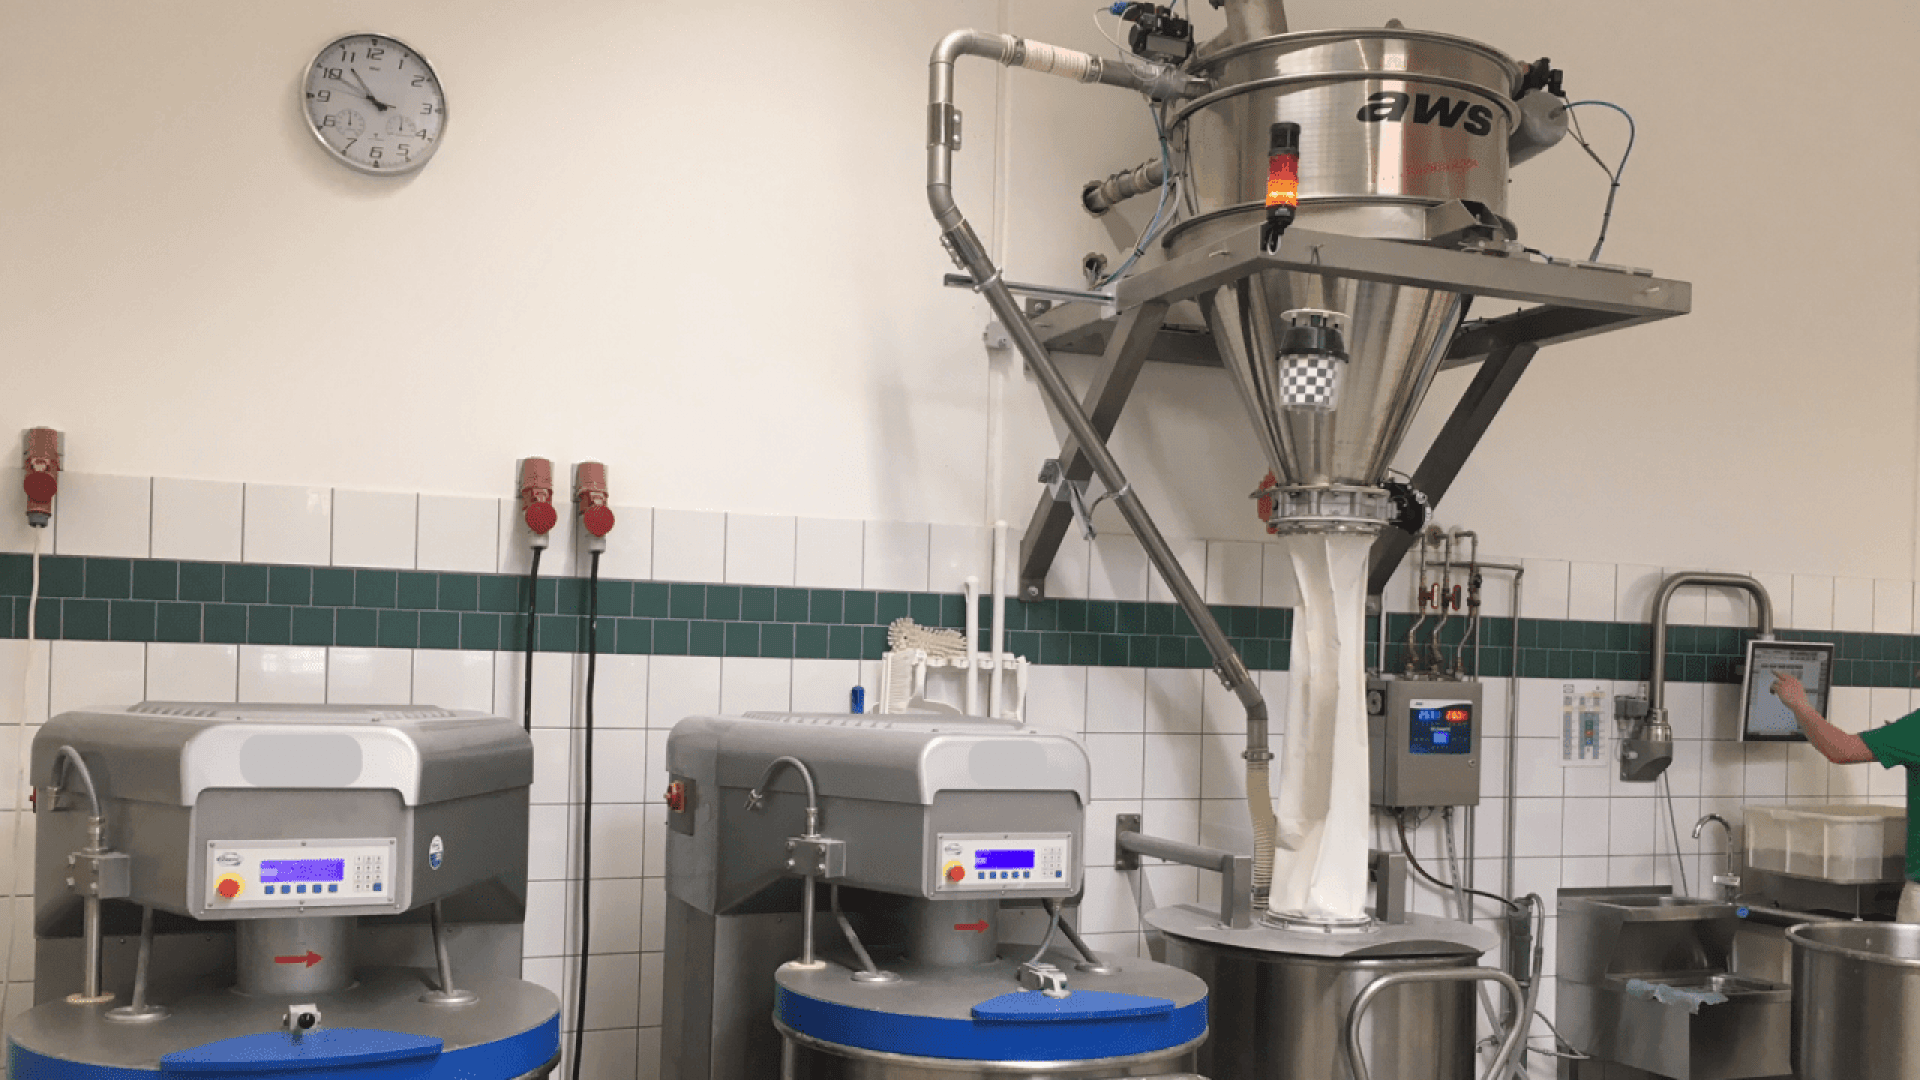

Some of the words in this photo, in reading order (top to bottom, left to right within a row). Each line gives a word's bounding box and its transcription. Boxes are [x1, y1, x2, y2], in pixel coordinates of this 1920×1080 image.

[342, 51, 355, 63] 11
[366, 48, 385, 60] 12
[398, 59, 404, 70] 1
[322, 68, 343, 80] 10
[411, 75, 425, 88] 2
[317, 90, 331, 102] 9
[420, 103, 433, 115] 3
[1356, 91, 1494, 136] aws
[415, 129, 427, 140] 4
[345, 138, 358, 150] 7
[396, 143, 410, 157] 5
[369, 147, 383, 159] 6
